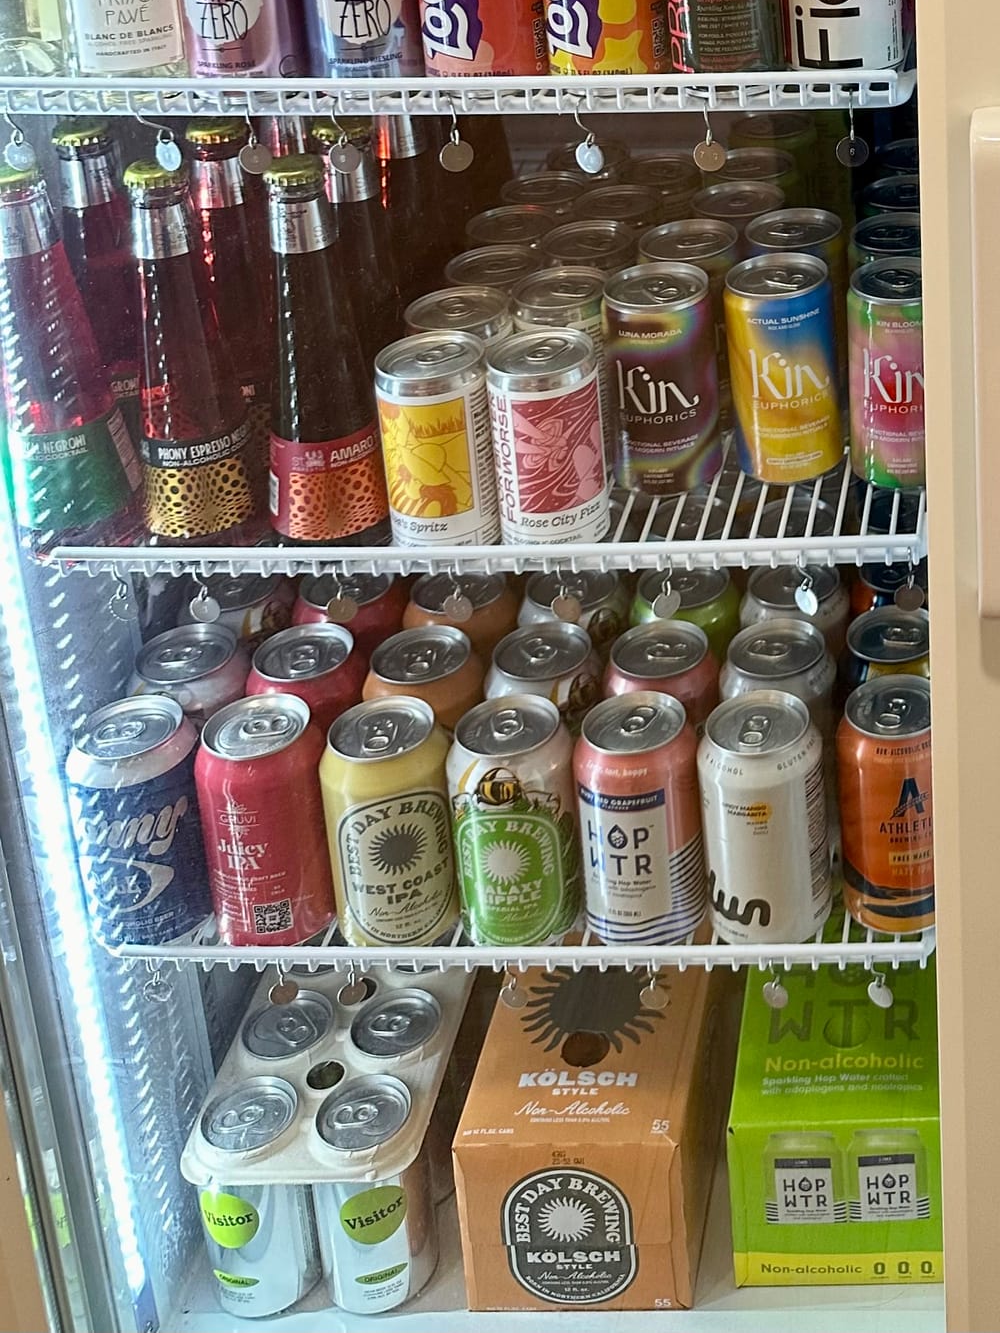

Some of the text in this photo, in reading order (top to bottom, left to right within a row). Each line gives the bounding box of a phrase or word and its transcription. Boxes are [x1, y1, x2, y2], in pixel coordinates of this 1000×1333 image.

[200, 0, 249, 43] ZERO
[84, 24, 174, 41] BLANC DE BLANCS
[780, 306, 822, 325] SUNSHINE
[640, 328, 683, 339] MORADA
[748, 348, 830, 401] Kin
[616, 359, 700, 415] Kin
[158, 436, 231, 460] PHONY ESPRESSO
[330, 435, 374, 462] AMARO
[496, 396, 517, 524] FOR WORSE
[521, 501, 601, 528] Rose City Fizz
[409, 520, 448, 533] Spritz
[610, 795, 659, 807] GRAPEFRUIT
[346, 800, 449, 877] BEST DAY BREWING
[218, 838, 269, 858] Juicy
[505, 820, 555, 877] BREWING
[227, 854, 261, 870] IPA
[352, 856, 449, 896] WEST COAST
[387, 888, 423, 906] IPA
[768, 998, 920, 1045] WTR
[765, 1053, 923, 1073] Non-alcoholic
[518, 1067, 638, 1088] KÖLSCH
[762, 1073, 870, 1087] Sparkling Hop Water
[552, 1088, 599, 1096] STYLE
[761, 1081, 923, 1095] with adaptogens nootropics
[514, 1100, 631, 1117] Non-Alcoholic
[651, 1119, 670, 1132] 55
[783, 1177, 826, 1192] HOP
[866, 1173, 910, 1190] HOP
[784, 1193, 828, 1208] WTR
[867, 1190, 911, 1206] WTR
[204, 1209, 254, 1229] Visitor
[344, 1195, 404, 1231] Visitor
[515, 1177, 621, 1244] BEST DAY BREWING
[527, 1249, 621, 1264] KÖLSCH
[364, 1267, 400, 1283] ORIGINAL
[760, 1262, 863, 1275] Non-alcoholic
[550, 1291, 590, 1300] NORTHERN
[654, 1298, 672, 1307] 55
